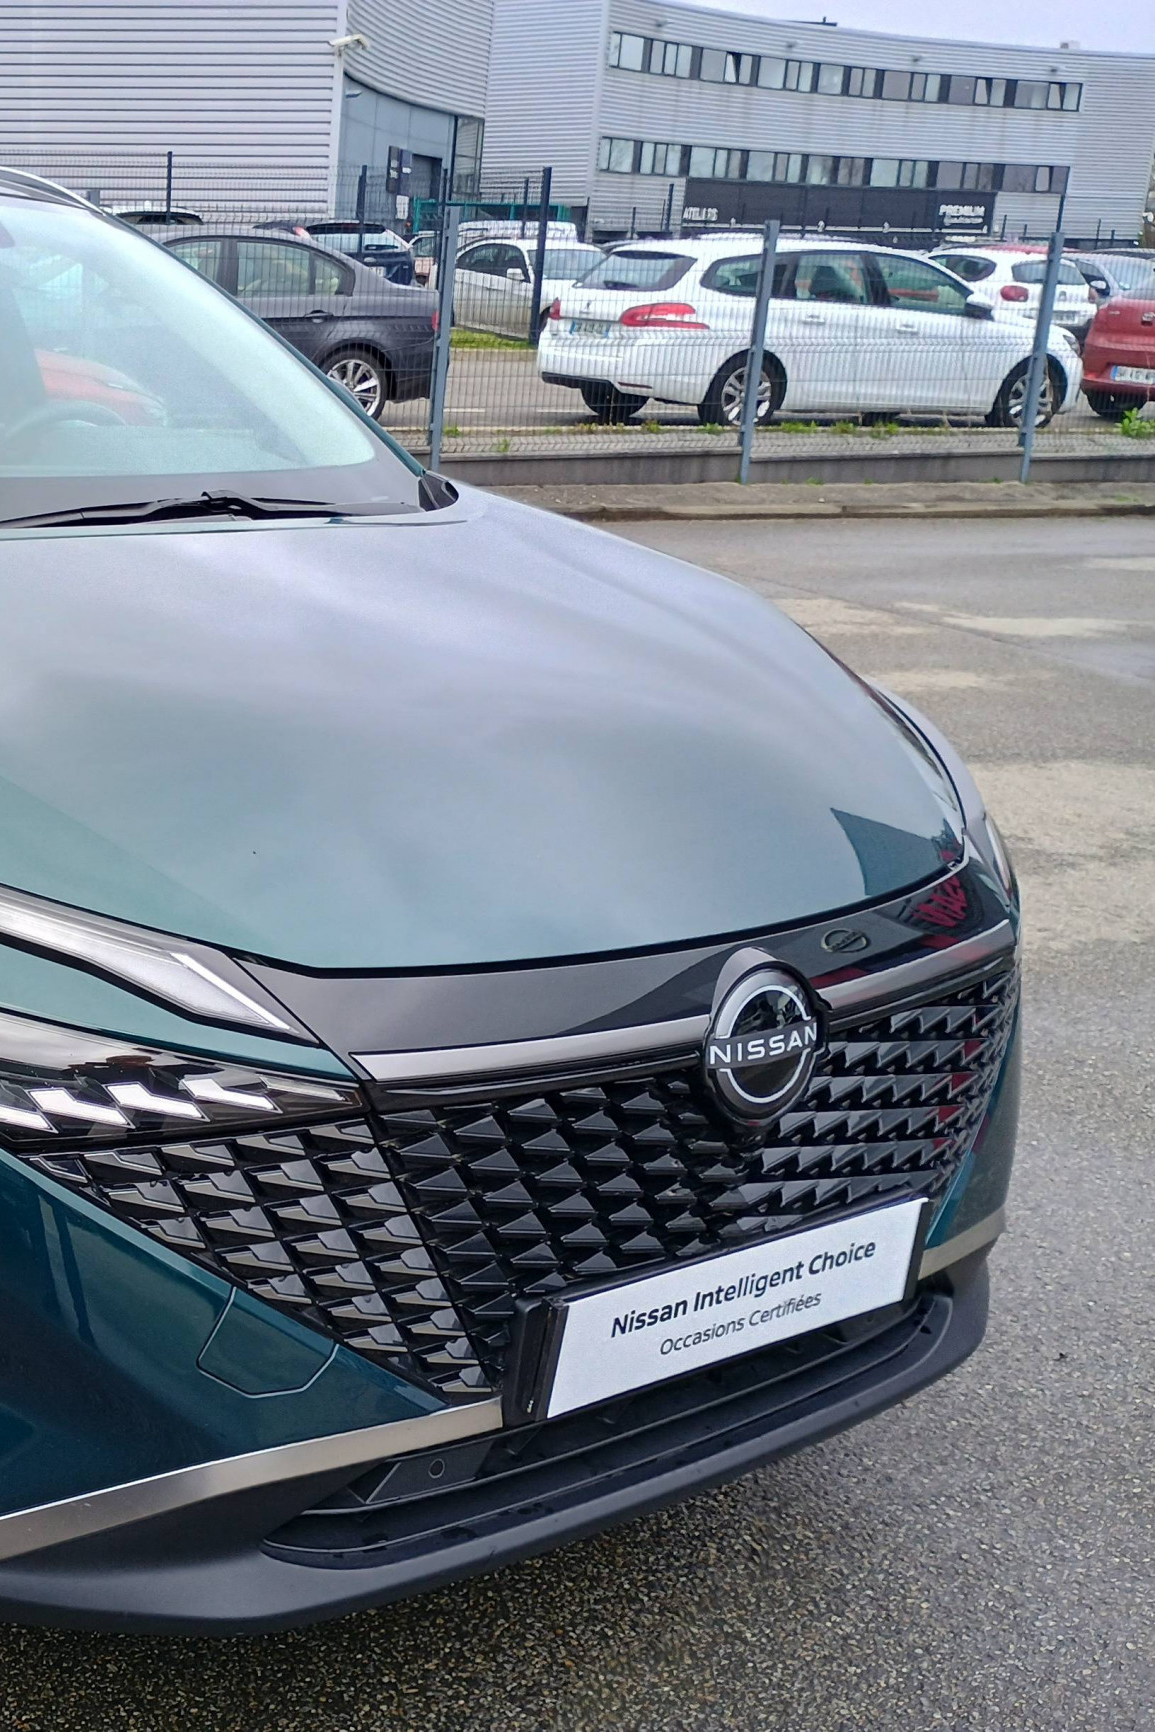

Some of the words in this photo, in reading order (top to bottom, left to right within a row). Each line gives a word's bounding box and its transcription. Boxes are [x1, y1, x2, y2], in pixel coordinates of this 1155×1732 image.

[709, 1021, 817, 1065] NISSAN
[611, 1299, 688, 1338] Nissan
[693, 1260, 804, 1312] Intelligent
[808, 1241, 876, 1275] Choice
[660, 1317, 746, 1355] Occasions
[748, 1293, 822, 1327] Certifiées
